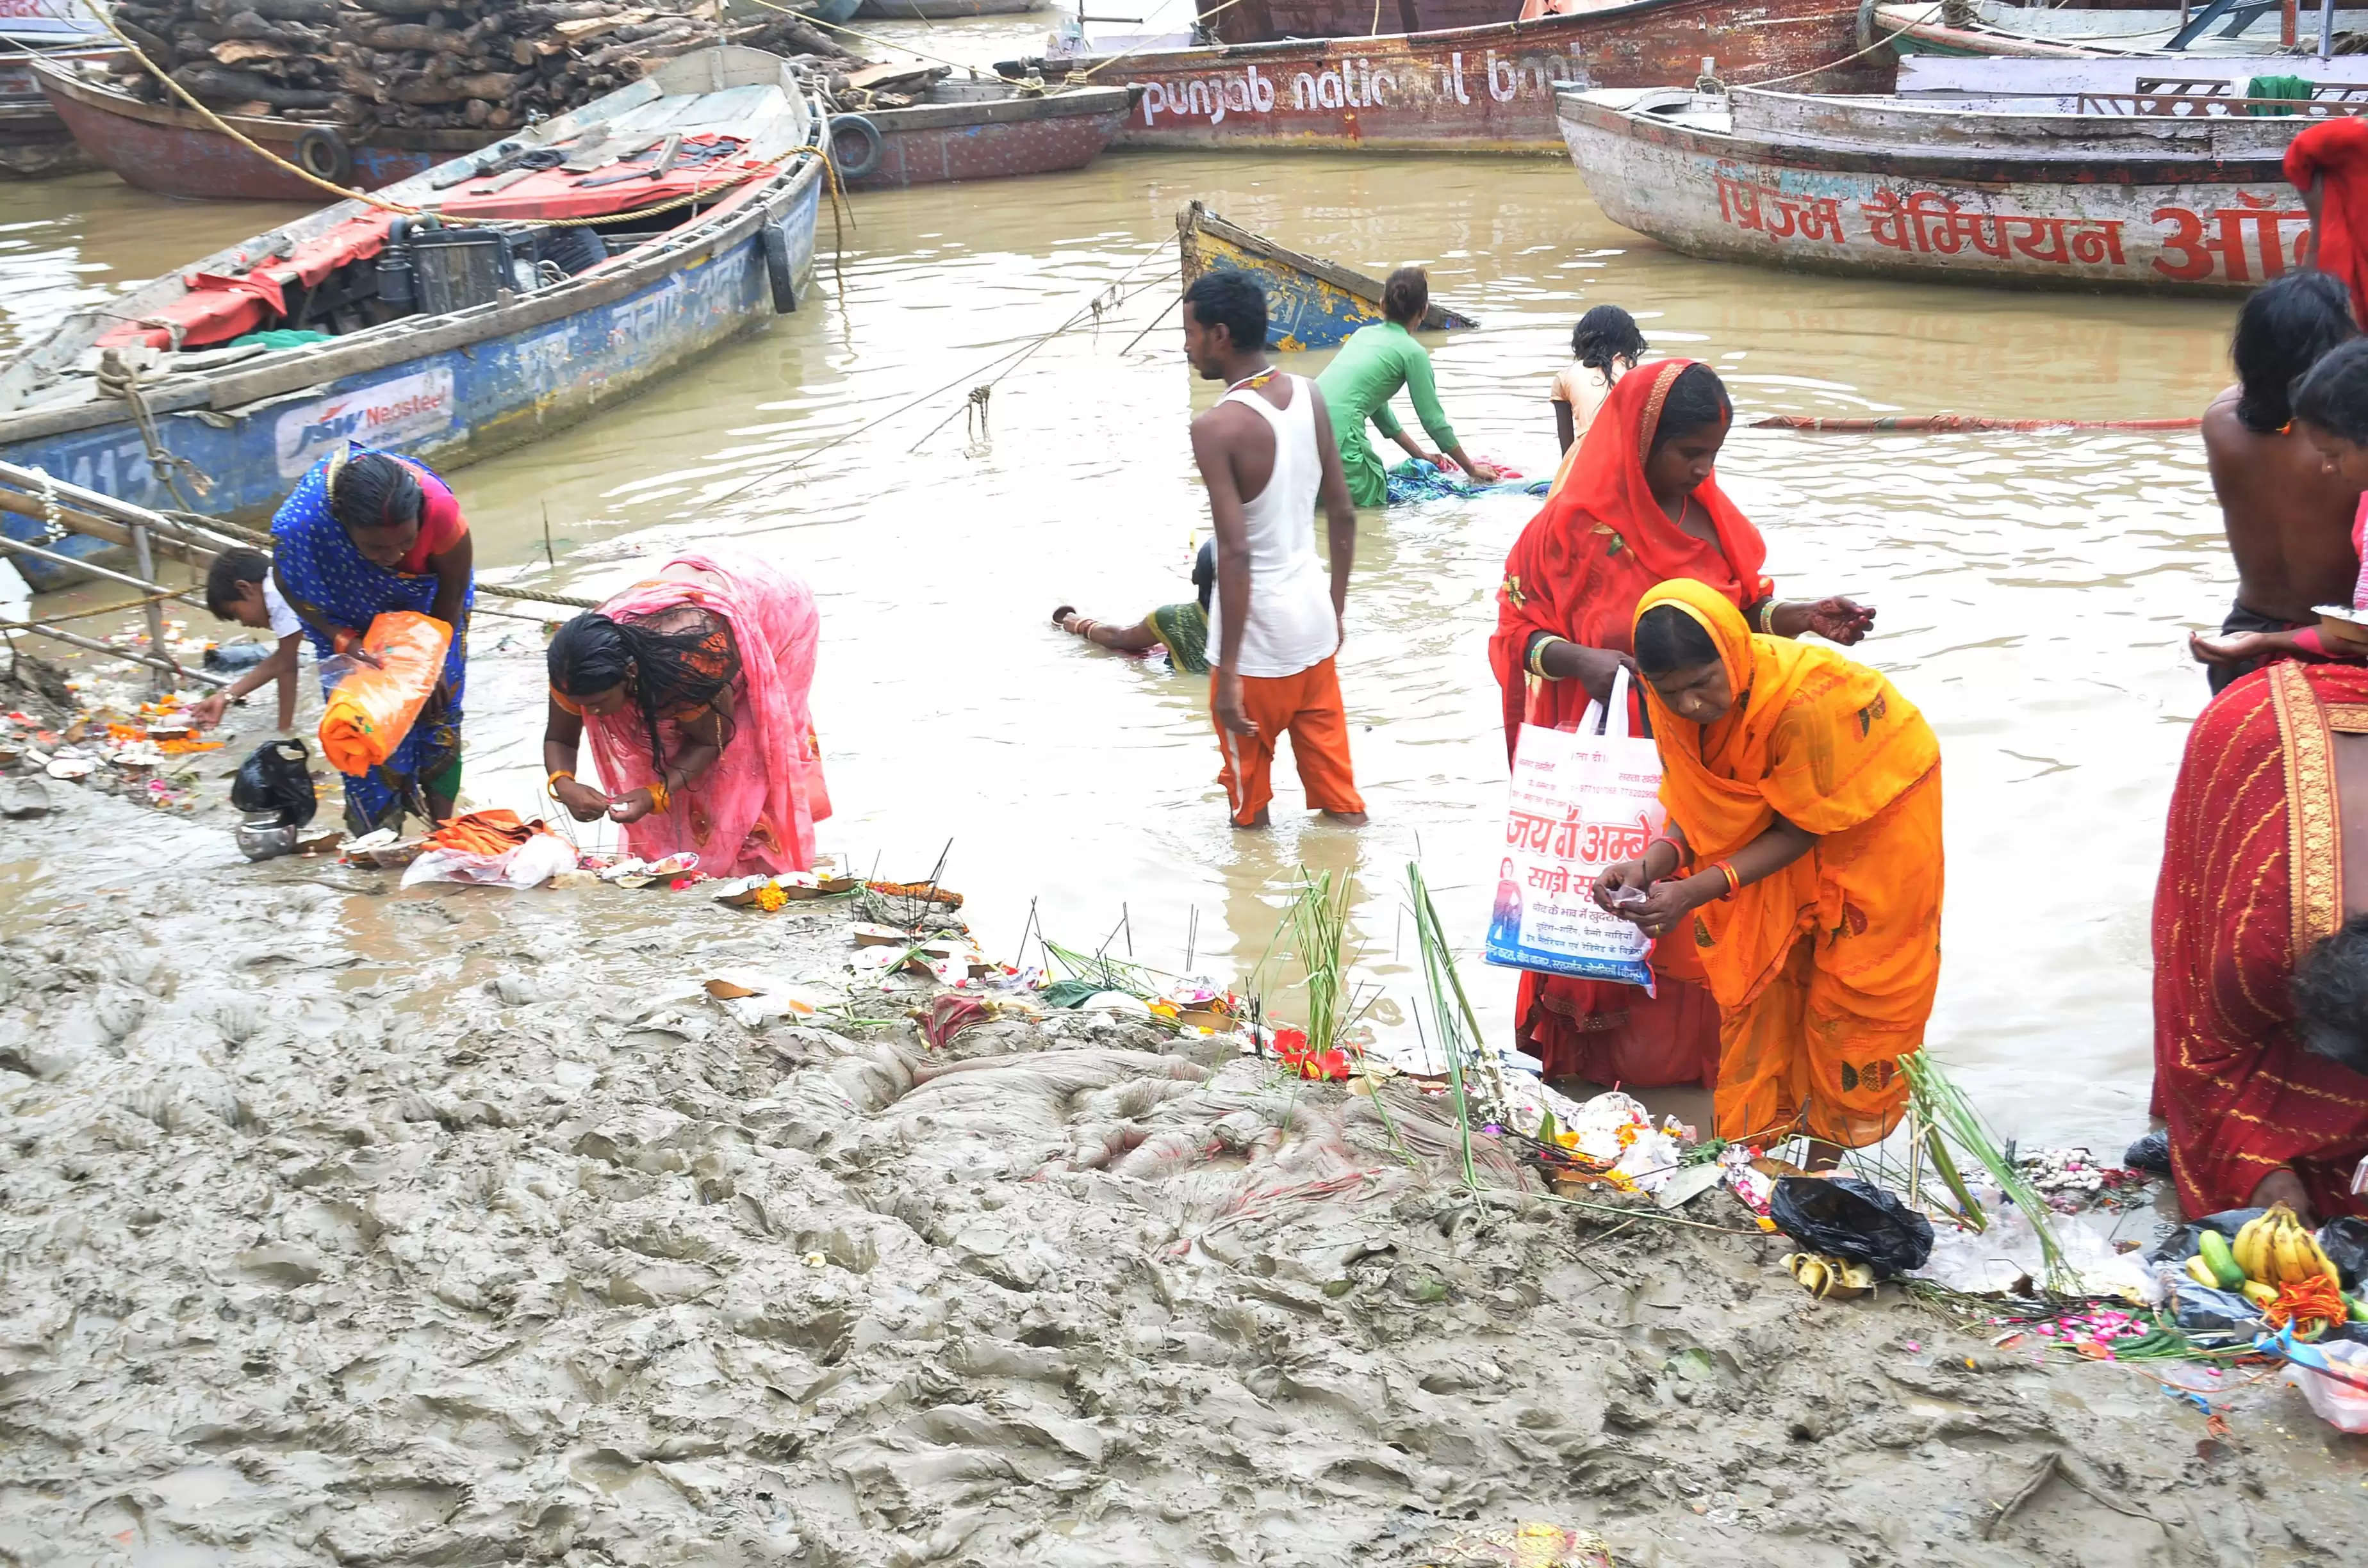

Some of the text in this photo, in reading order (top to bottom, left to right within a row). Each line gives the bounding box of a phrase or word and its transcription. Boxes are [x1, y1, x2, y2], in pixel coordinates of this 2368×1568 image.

[1142, 65, 1274, 126] punjab
[1860, 186, 2126, 265] चैम्पियन
[366, 386, 447, 429] Neosteel
[1506, 810, 1556, 853] जय
[1581, 813, 1652, 862] अम्बे
[1561, 907, 1577, 917] भाव
[1574, 874, 1597, 905] सू
